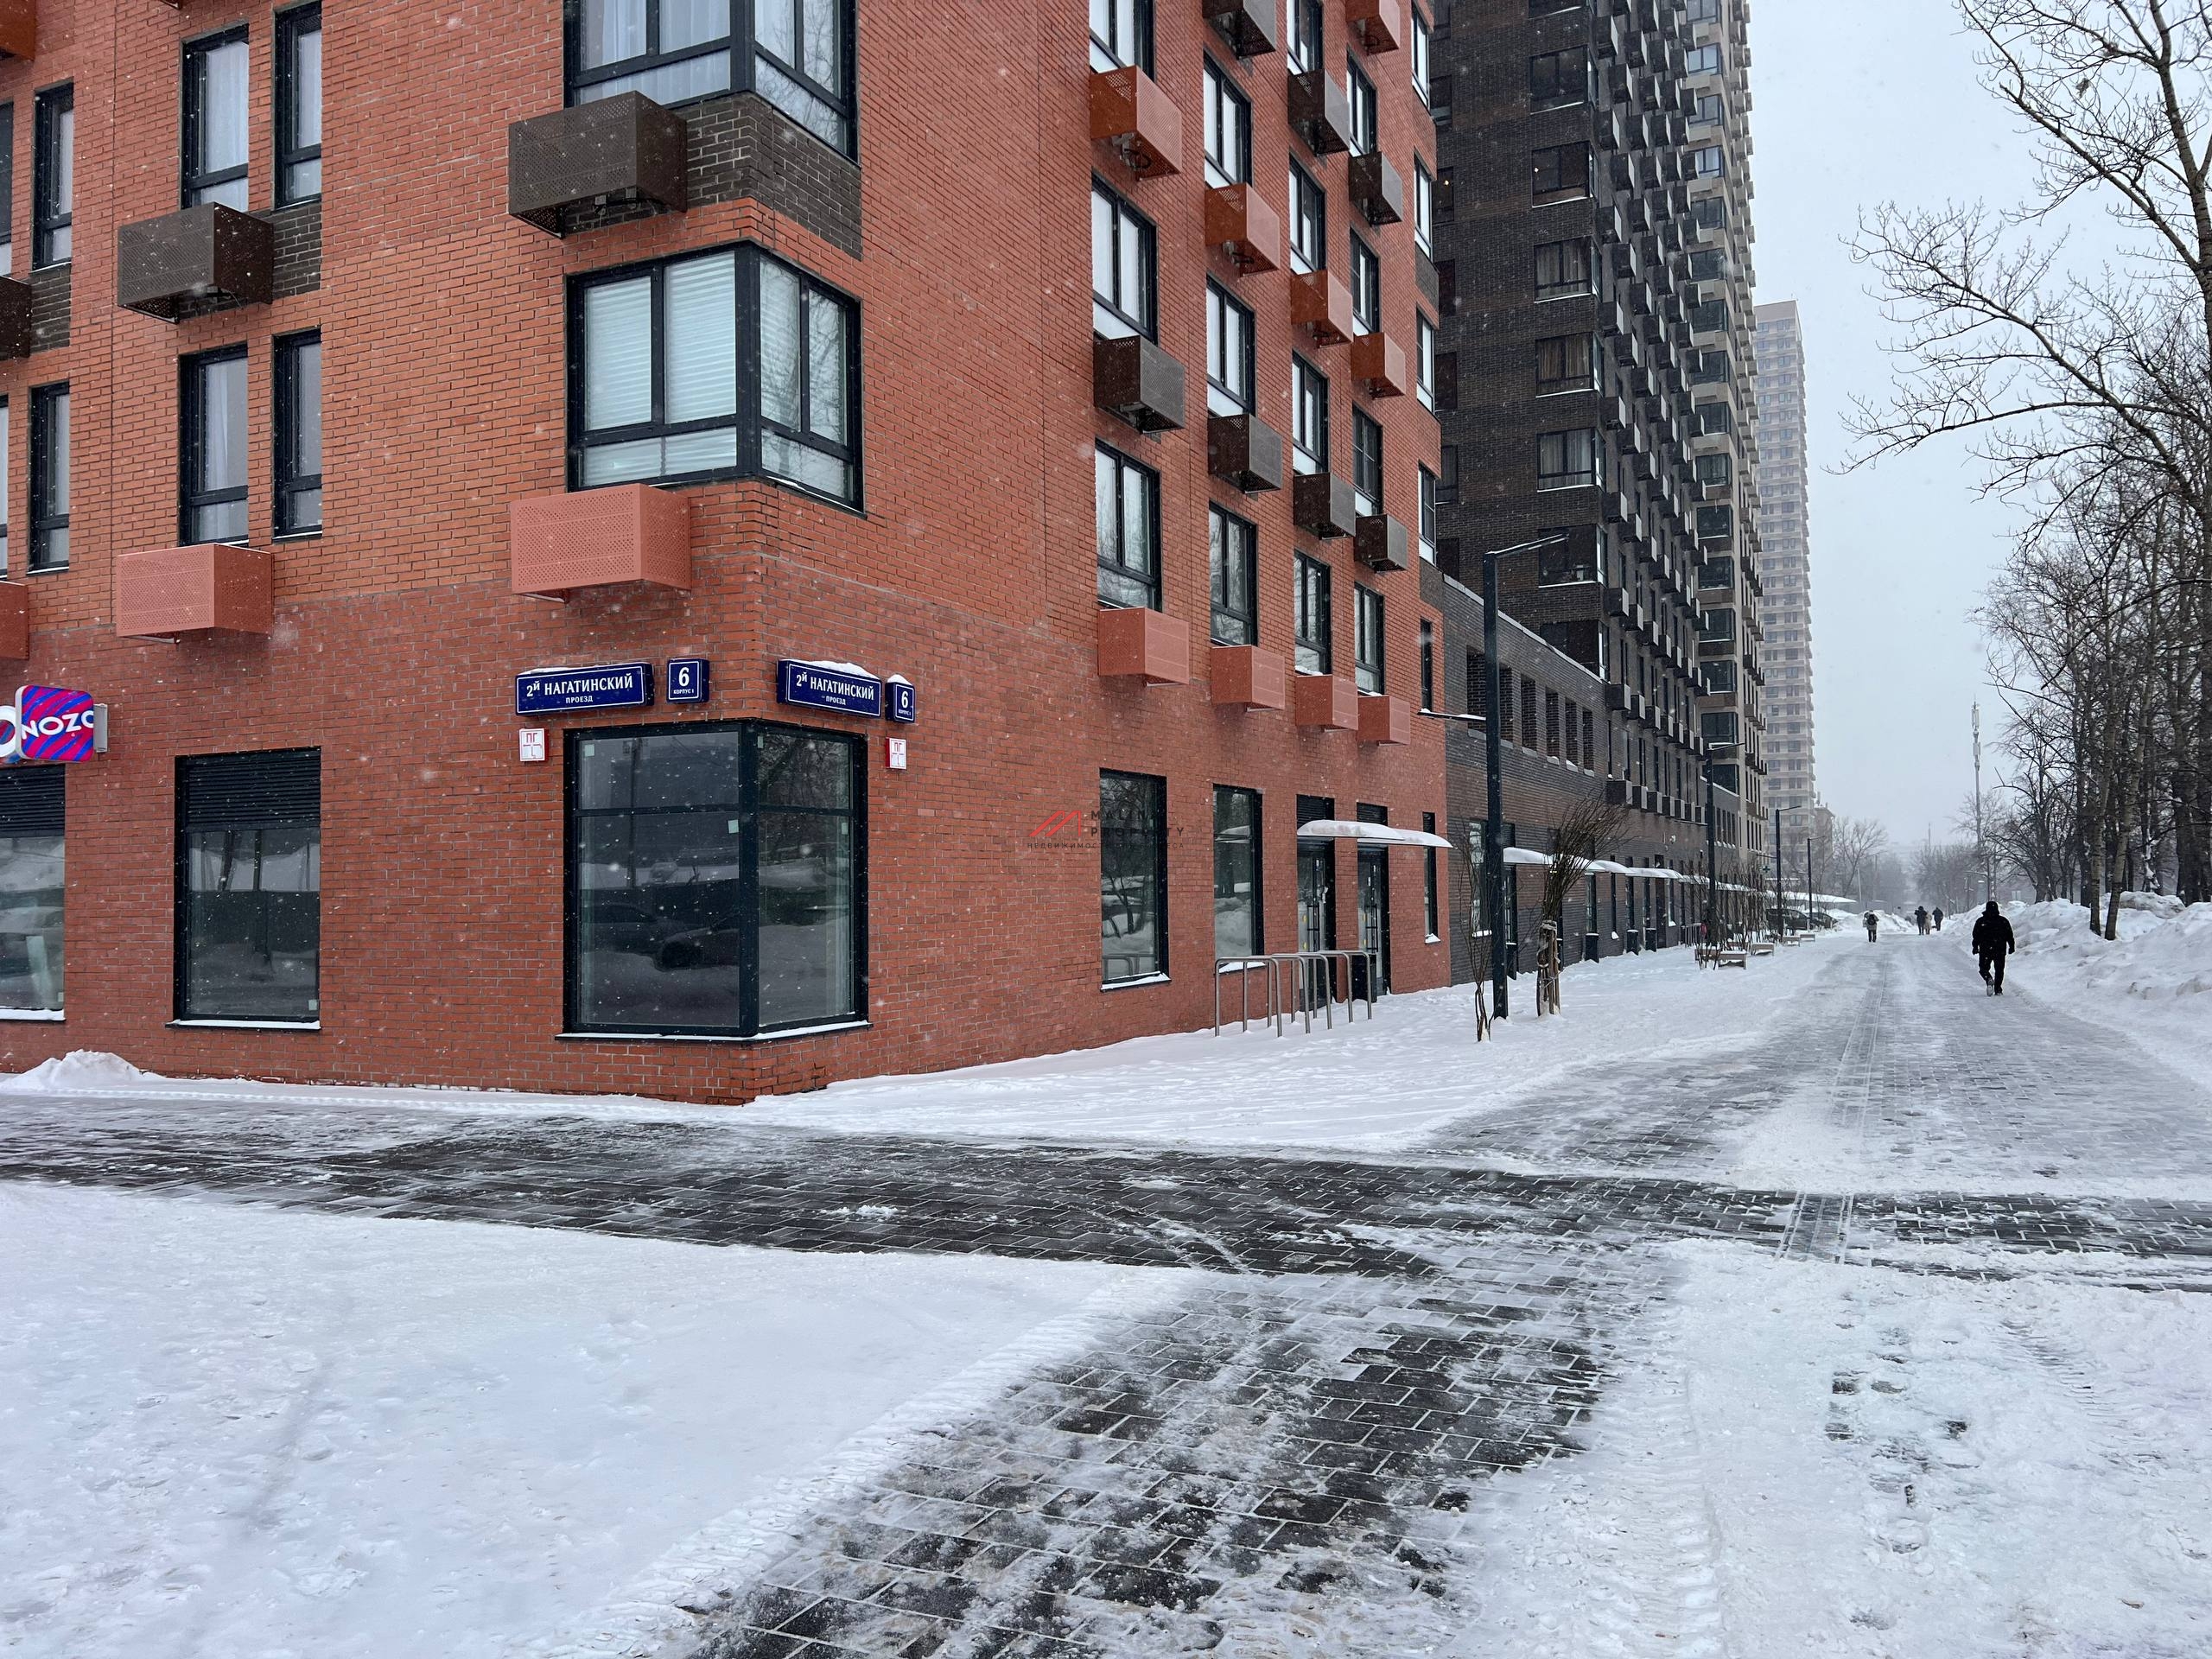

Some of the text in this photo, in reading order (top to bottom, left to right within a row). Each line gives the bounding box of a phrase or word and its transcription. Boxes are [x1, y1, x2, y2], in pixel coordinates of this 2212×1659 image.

[544, 673, 633, 696] НАГАТИНСКИЙ
[677, 666, 690, 687] 6
[810, 677, 874, 701] НАГАТИНСКИЙ
[565, 695, 594, 704] ПРОЕЗД
[825, 696, 846, 705] ПРОЕЗД
[901, 690, 909, 709] 6
